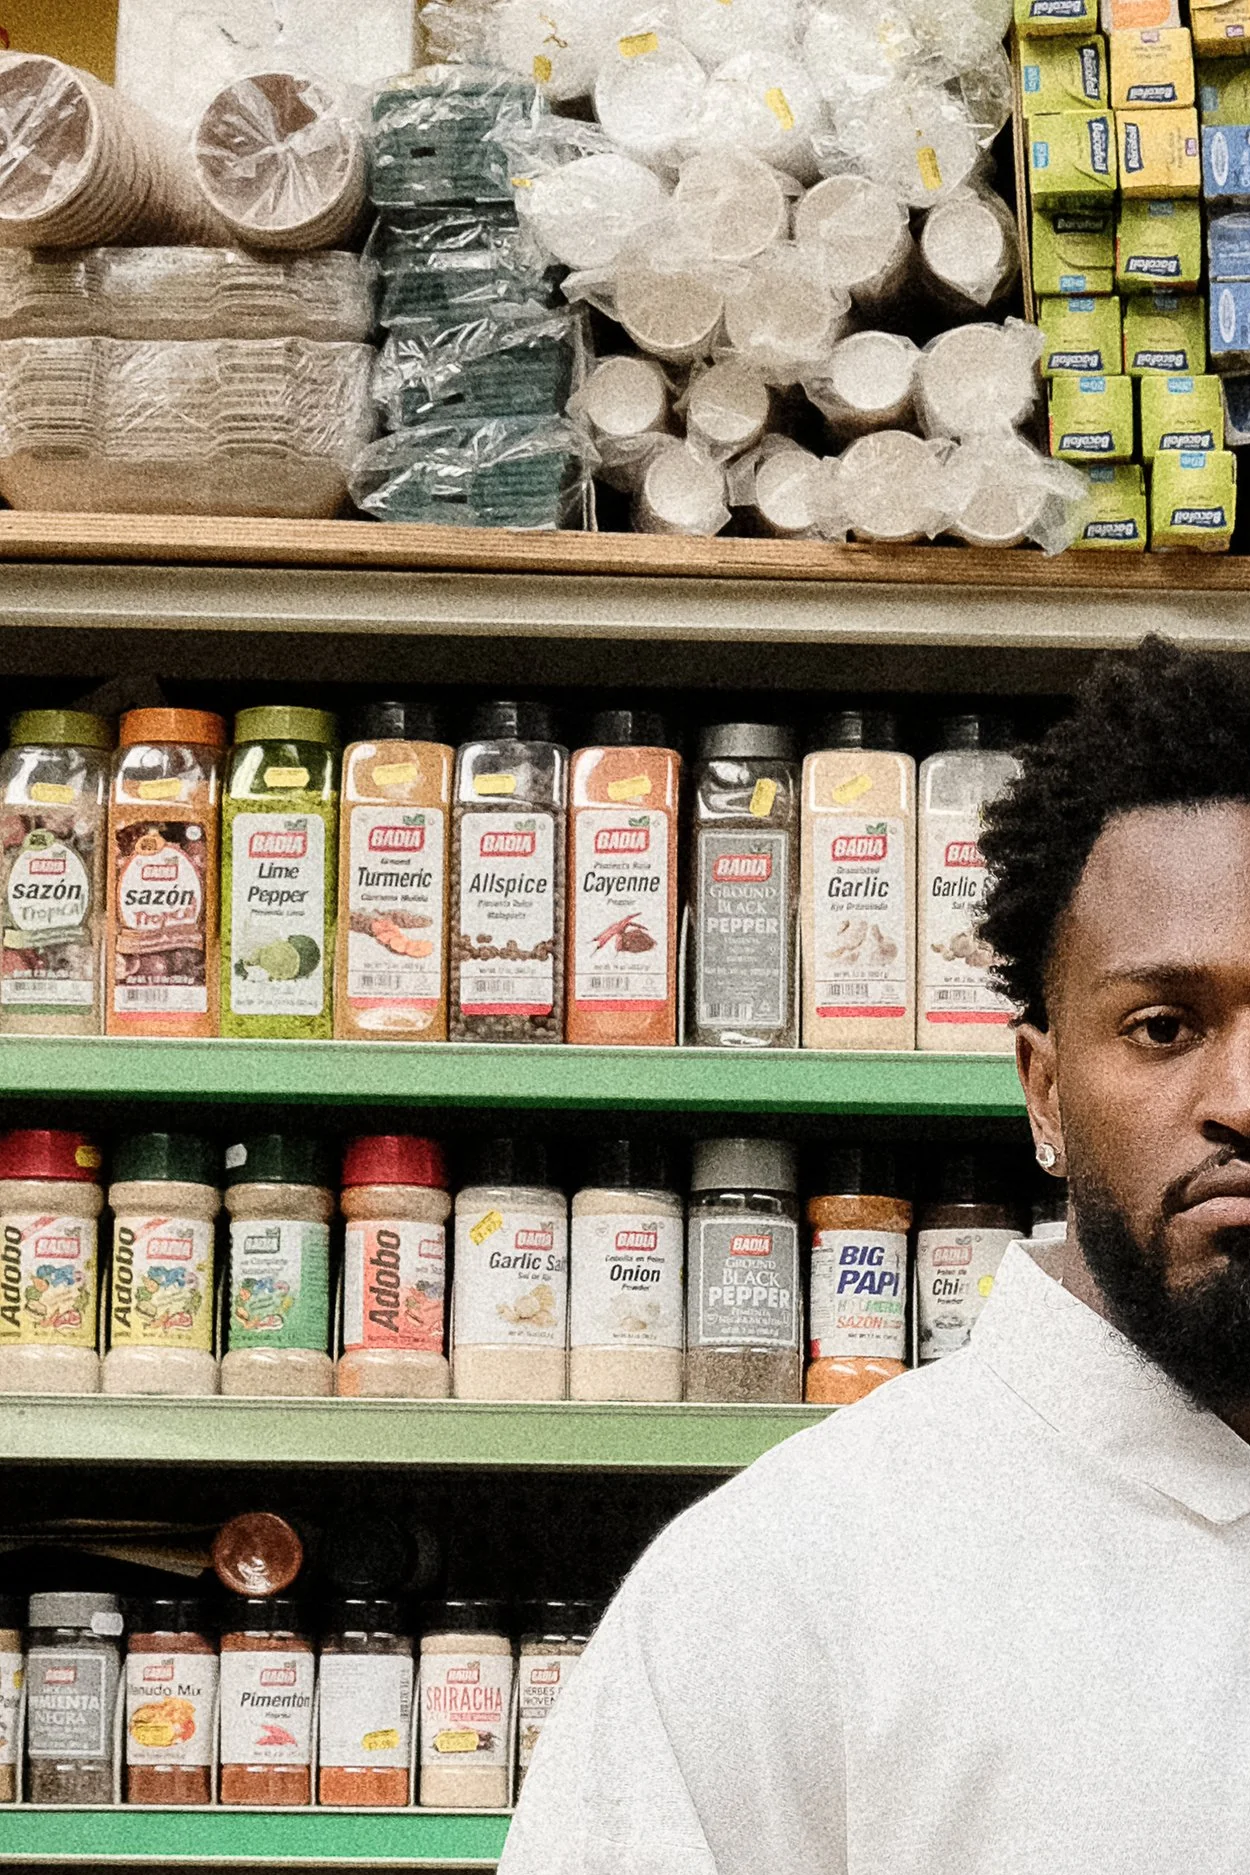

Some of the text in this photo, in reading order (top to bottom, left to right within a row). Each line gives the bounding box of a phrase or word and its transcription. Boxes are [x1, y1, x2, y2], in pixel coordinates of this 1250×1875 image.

[1082, 48, 1099, 97] Bacofoil
[1091, 121, 1107, 172] Bacofoil
[1129, 256, 1178, 274] Bacofoil
[1051, 352, 1100, 369] Bacofoil
[1063, 433, 1111, 450] Bacofoil
[1174, 508, 1223, 527] Bacofoil
[371, 829, 422, 849] BADIA
[482, 834, 533, 854] BADIA
[597, 831, 647, 850] BADIA
[834, 837, 885, 859] BADIA
[258, 862, 300, 880] Lime
[358, 867, 432, 888] Turmeric
[716, 857, 769, 878] BADIA
[12, 879, 82, 900] sazón
[469, 873, 547, 897] Allspice
[583, 872, 660, 896] Cayenne
[709, 885, 777, 899] GROUND
[828, 876, 890, 898] Garlic
[932, 876, 977, 898] Garlic
[124, 884, 194, 906] sazón
[247, 886, 309, 906] Pepper
[717, 901, 768, 915] BLACK
[707, 917, 779, 934] PEPPER
[732, 1236, 770, 1254] BADIA
[489, 1251, 541, 1270] Garlic
[725, 1257, 777, 1269] GROUND
[839, 1245, 885, 1266] BIG
[0, 1226, 22, 1328] Adobo
[114, 1227, 135, 1328] Adobo
[368, 1229, 401, 1333] Adobo
[610, 1264, 661, 1282] Onion
[722, 1269, 780, 1287] BLACK
[708, 1286, 790, 1308] PEPPER
[178, 1684, 201, 1697] Mix
[426, 1687, 502, 1711] SRIRACHA
[35, 1712, 86, 1725] NEGRA
